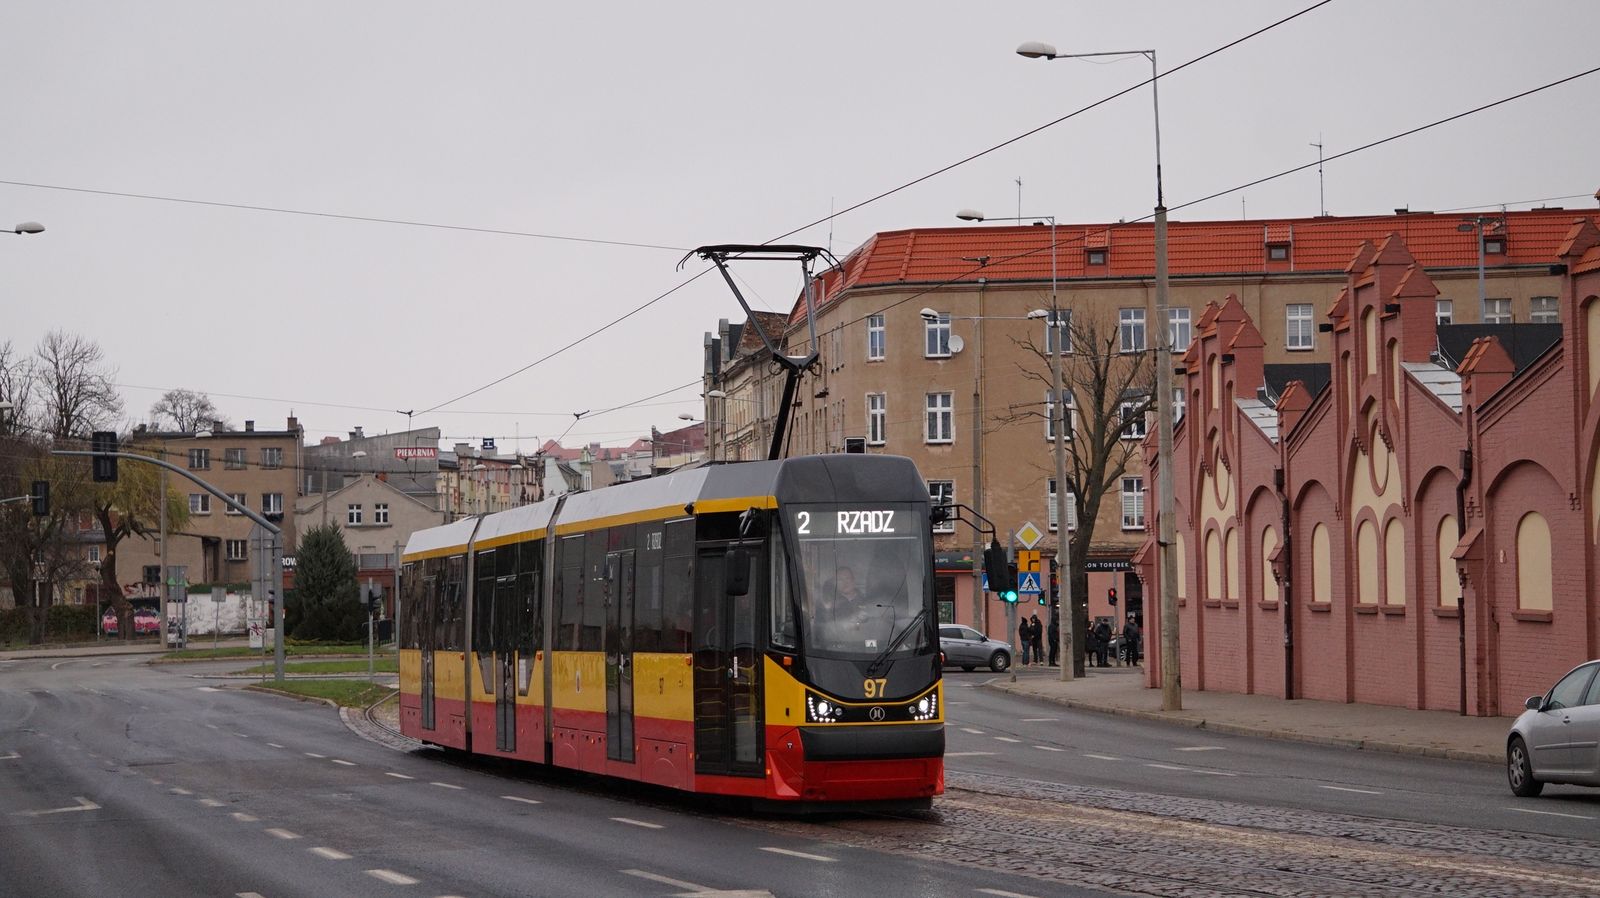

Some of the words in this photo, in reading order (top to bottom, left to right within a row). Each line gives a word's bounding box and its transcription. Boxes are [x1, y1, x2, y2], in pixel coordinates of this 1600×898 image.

[397, 448, 435, 457] PIEKARNIA
[797, 511, 811, 534] 2
[837, 510, 895, 534] RZADZ
[863, 678, 888, 699] 97
